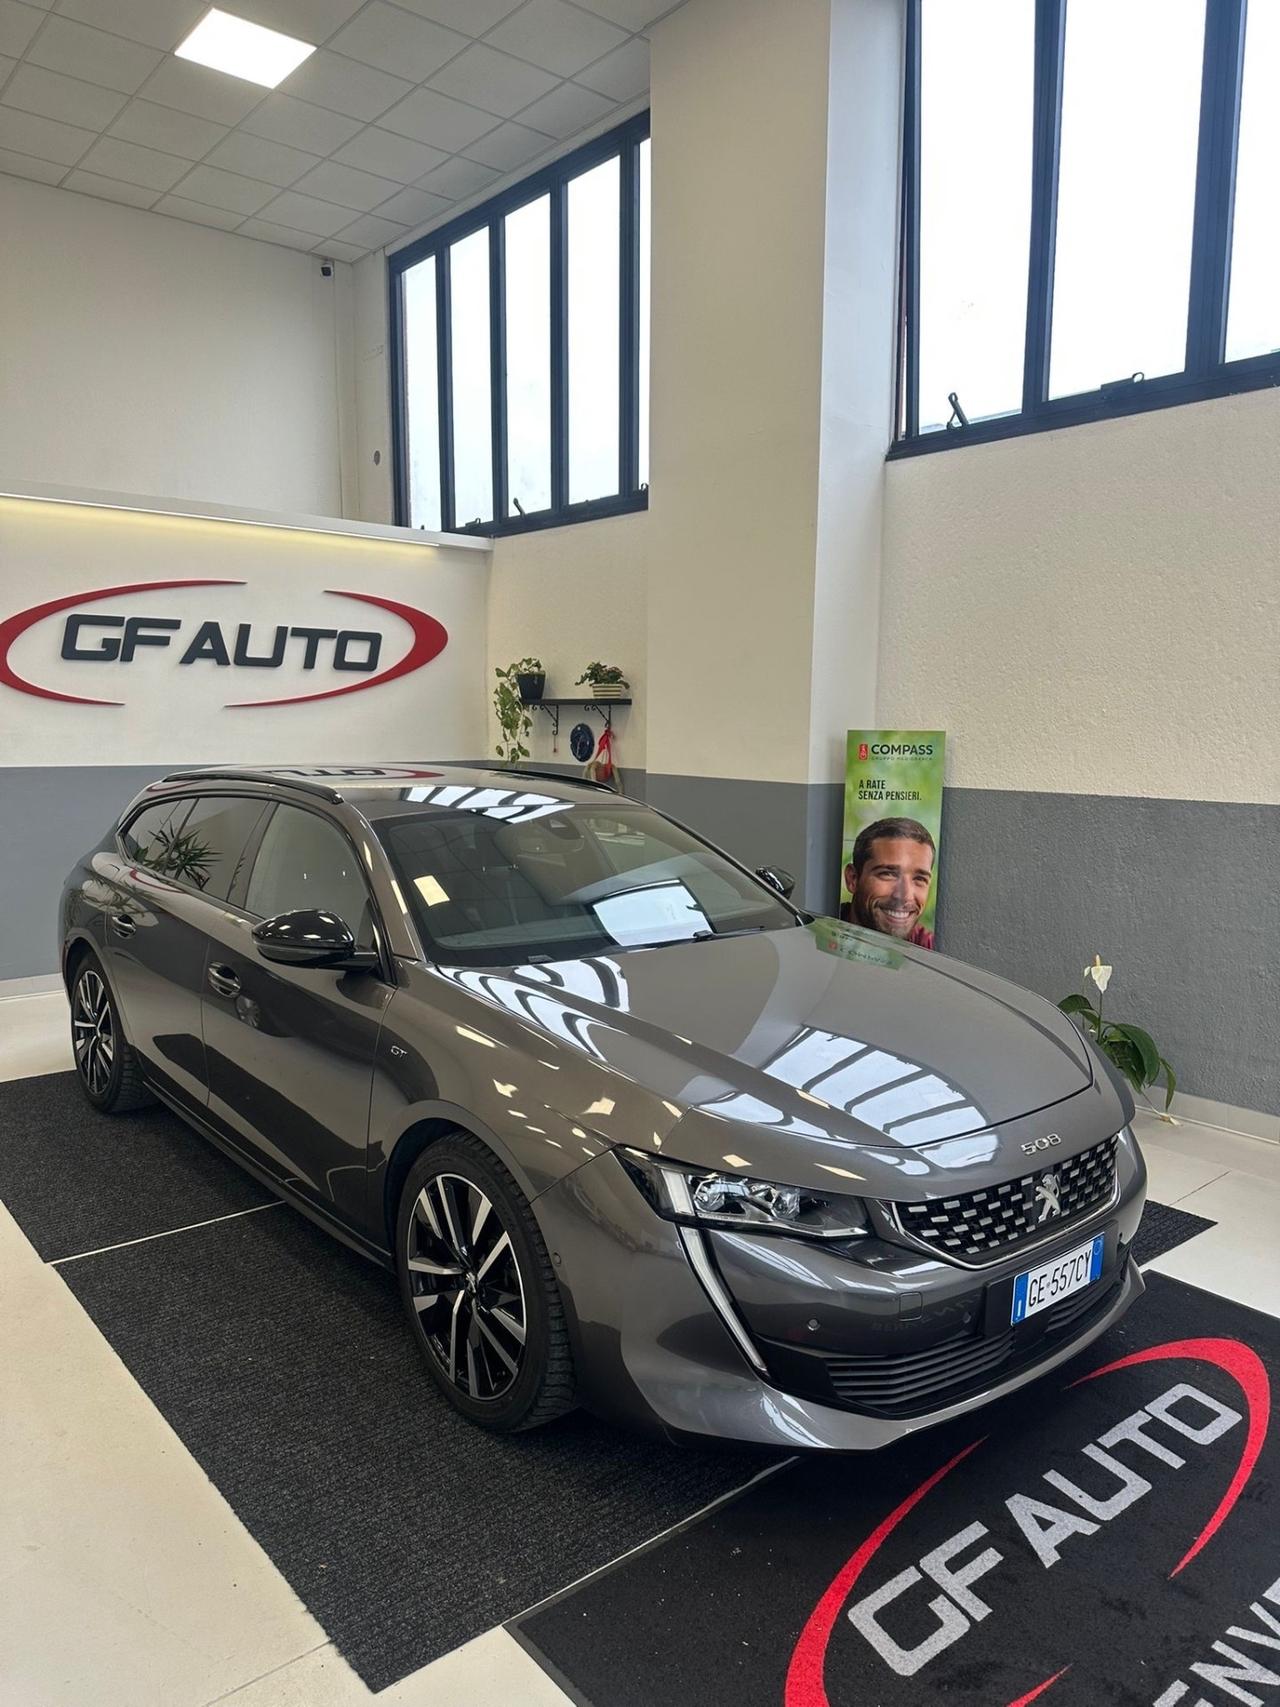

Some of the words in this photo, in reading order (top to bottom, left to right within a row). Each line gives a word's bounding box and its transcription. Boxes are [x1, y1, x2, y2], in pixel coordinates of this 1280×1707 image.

[61, 614, 182, 662] GF
[179, 621, 382, 672] AUTO
[871, 744, 933, 755] COMPASS
[858, 780, 864, 789] A
[866, 780, 886, 789] RATE
[858, 790, 883, 800] SENZA
[886, 791, 922, 800] PENSIERI.
[391, 1045, 408, 1058] GT
[1020, 1133, 1061, 1155] 508
[847, 1520, 1004, 1676] GF
[1004, 1383, 1243, 1568] AUTO
